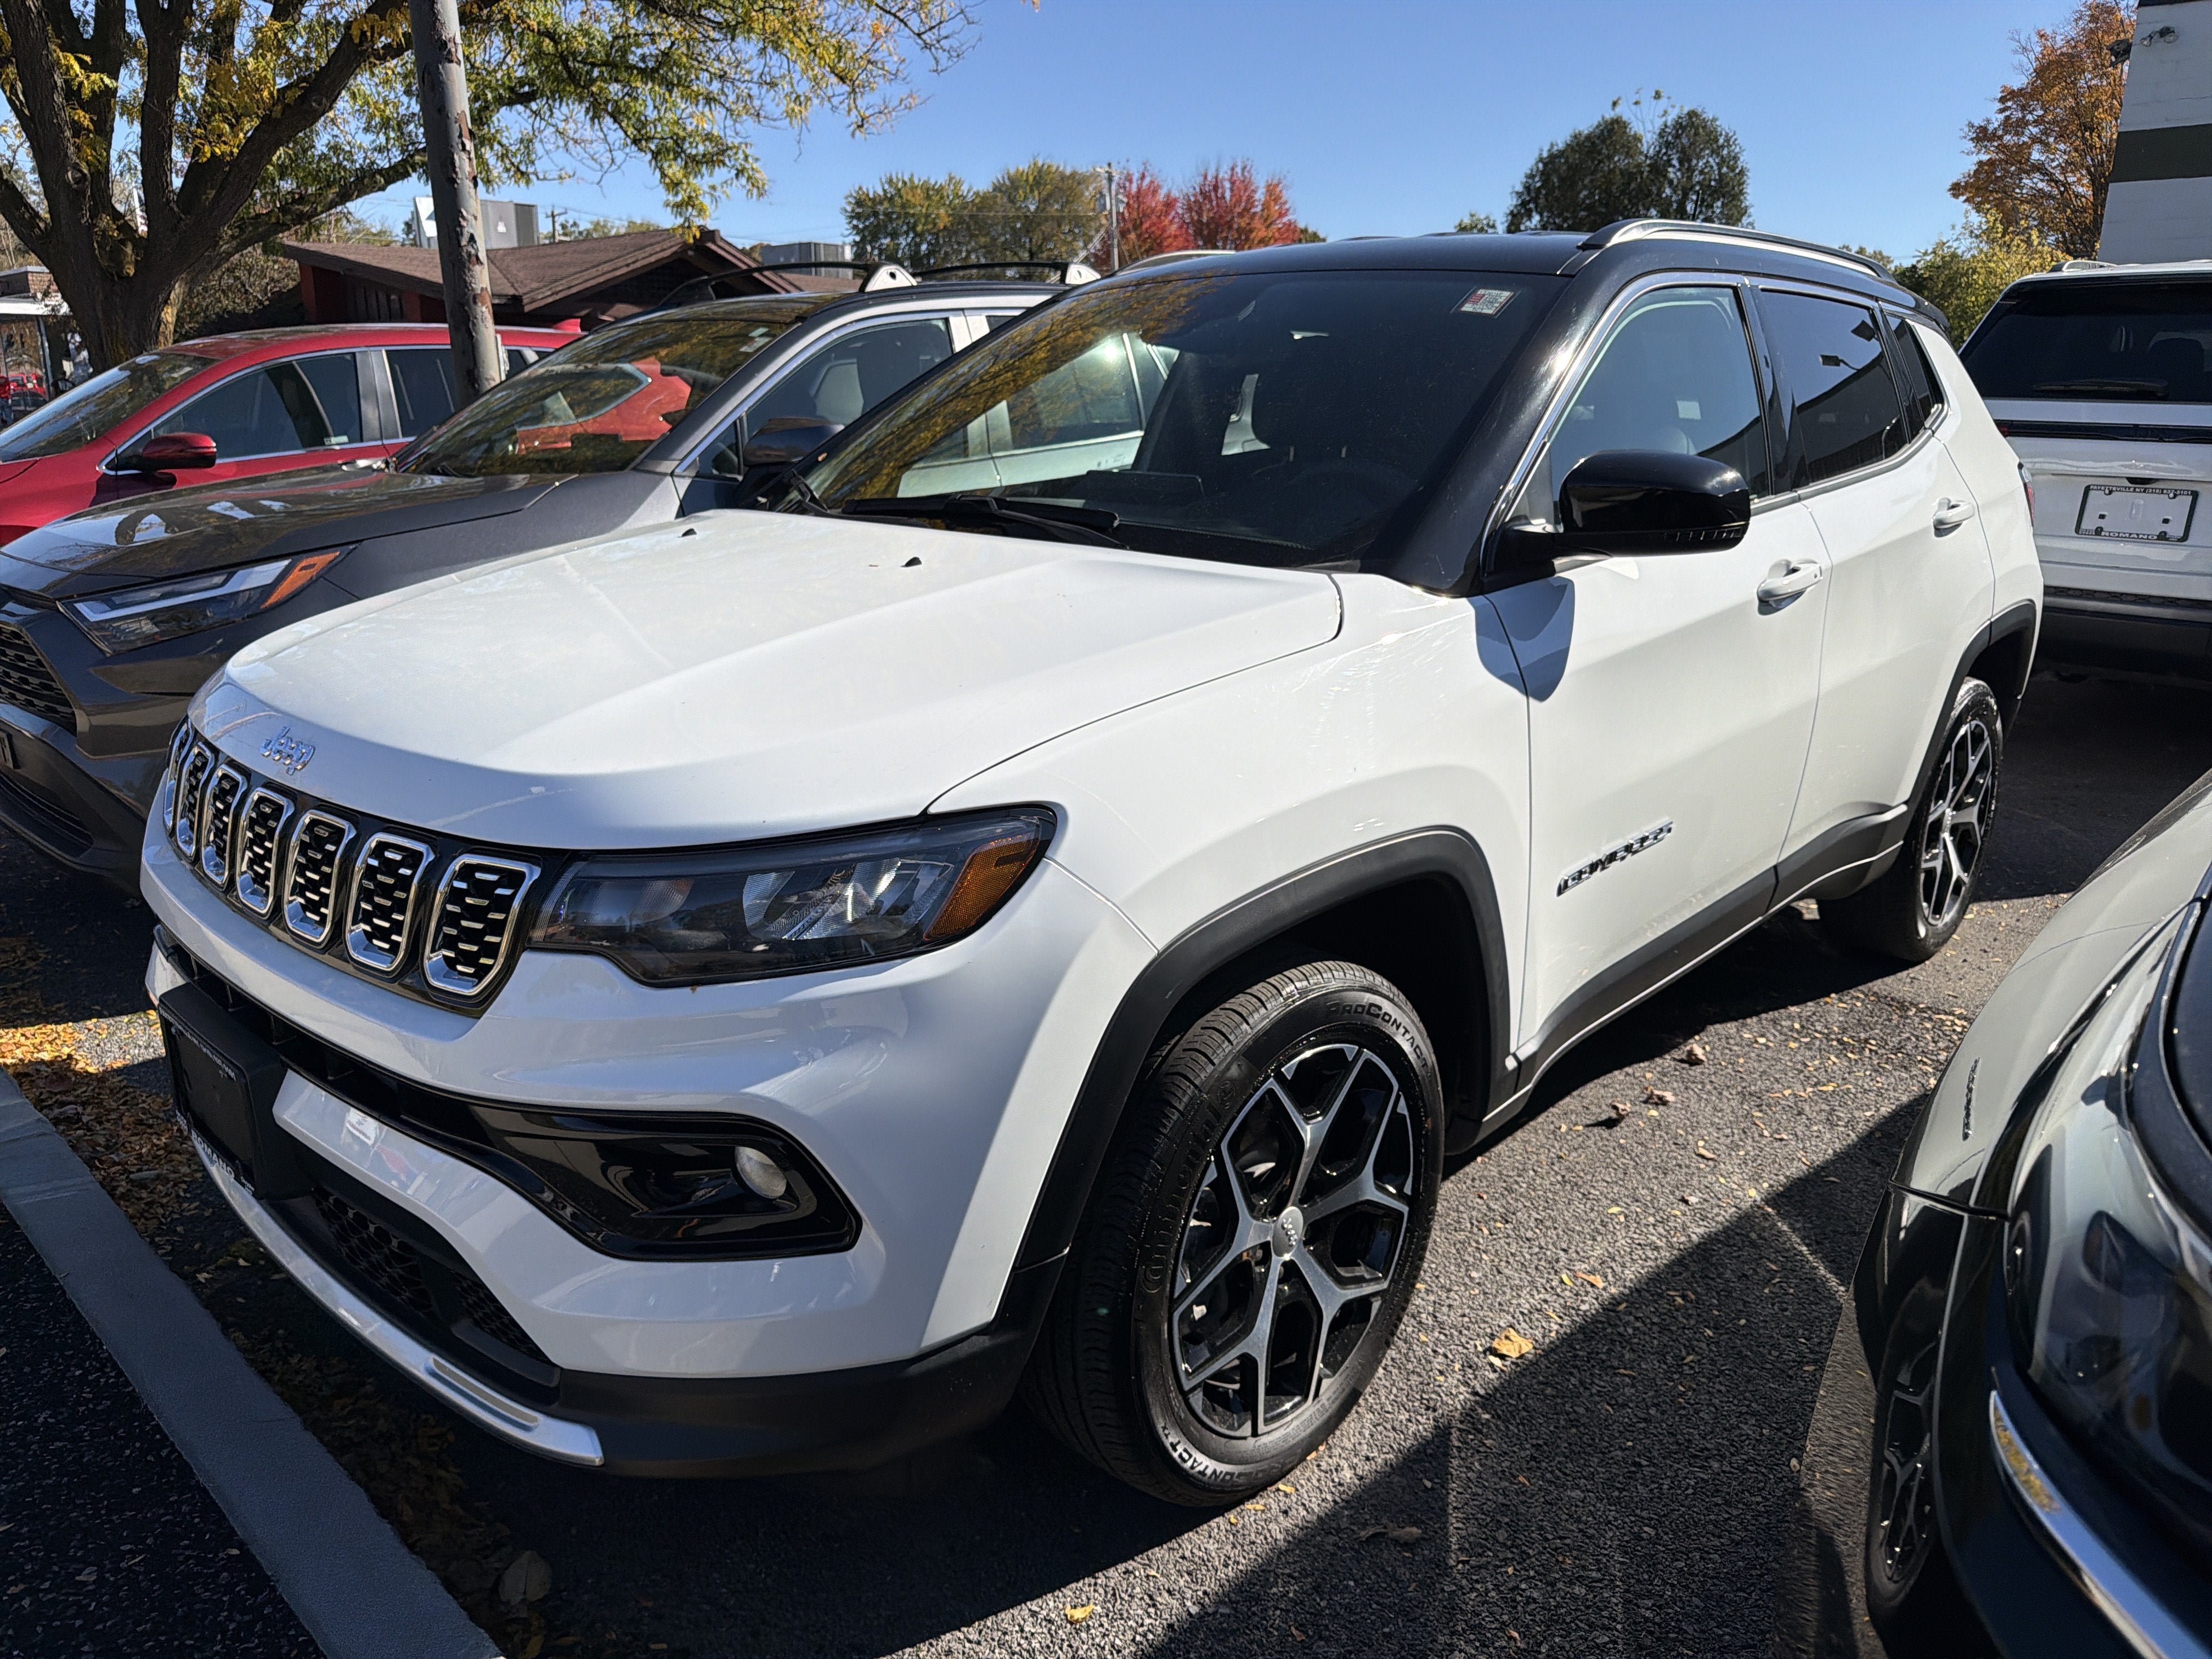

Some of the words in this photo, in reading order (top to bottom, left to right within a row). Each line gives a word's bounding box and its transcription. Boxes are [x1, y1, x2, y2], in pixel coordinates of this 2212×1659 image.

[2101, 531, 2158, 540] ROMANO
[259, 725, 316, 776] Jeep
[190, 1128, 235, 1179] ROMANO
